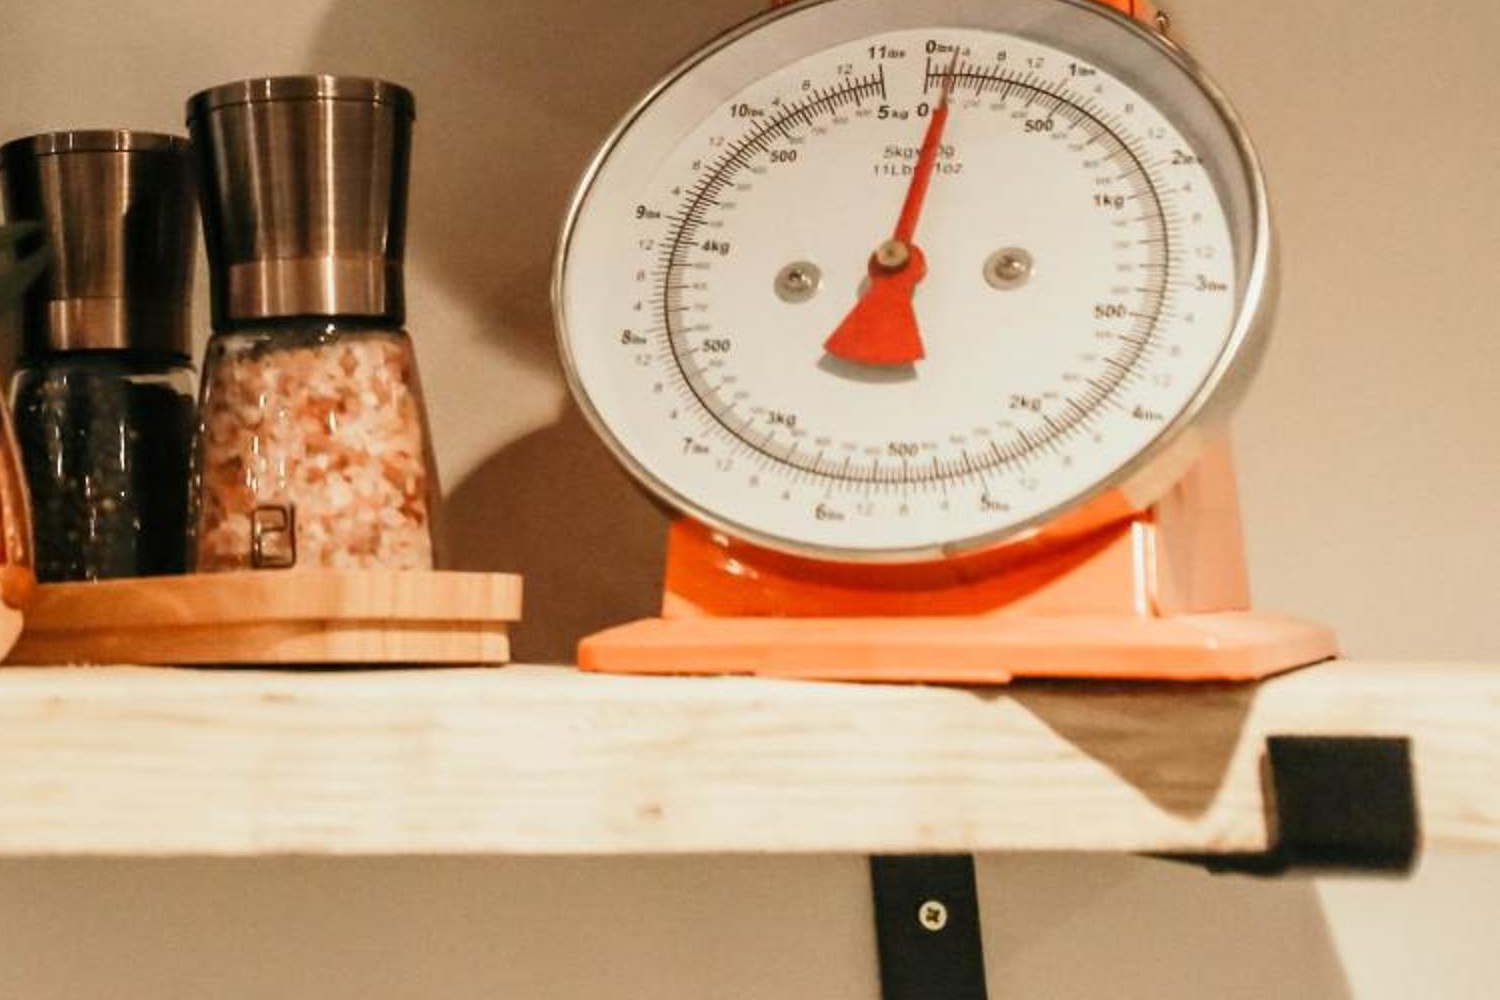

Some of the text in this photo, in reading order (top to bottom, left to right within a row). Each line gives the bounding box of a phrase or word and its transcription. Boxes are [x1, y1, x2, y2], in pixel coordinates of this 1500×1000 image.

[917, 103, 929, 117] 0
[1024, 119, 1054, 133] 500
[770, 149, 797, 163] 500
[1093, 193, 1125, 210] 1kg
[701, 239, 731, 256] 4kg
[1093, 304, 1126, 318] 500
[702, 338, 731, 353] 500
[1009, 394, 1041, 412] 2kg
[767, 411, 797, 429] 3kg
[888, 441, 918, 456] 500
